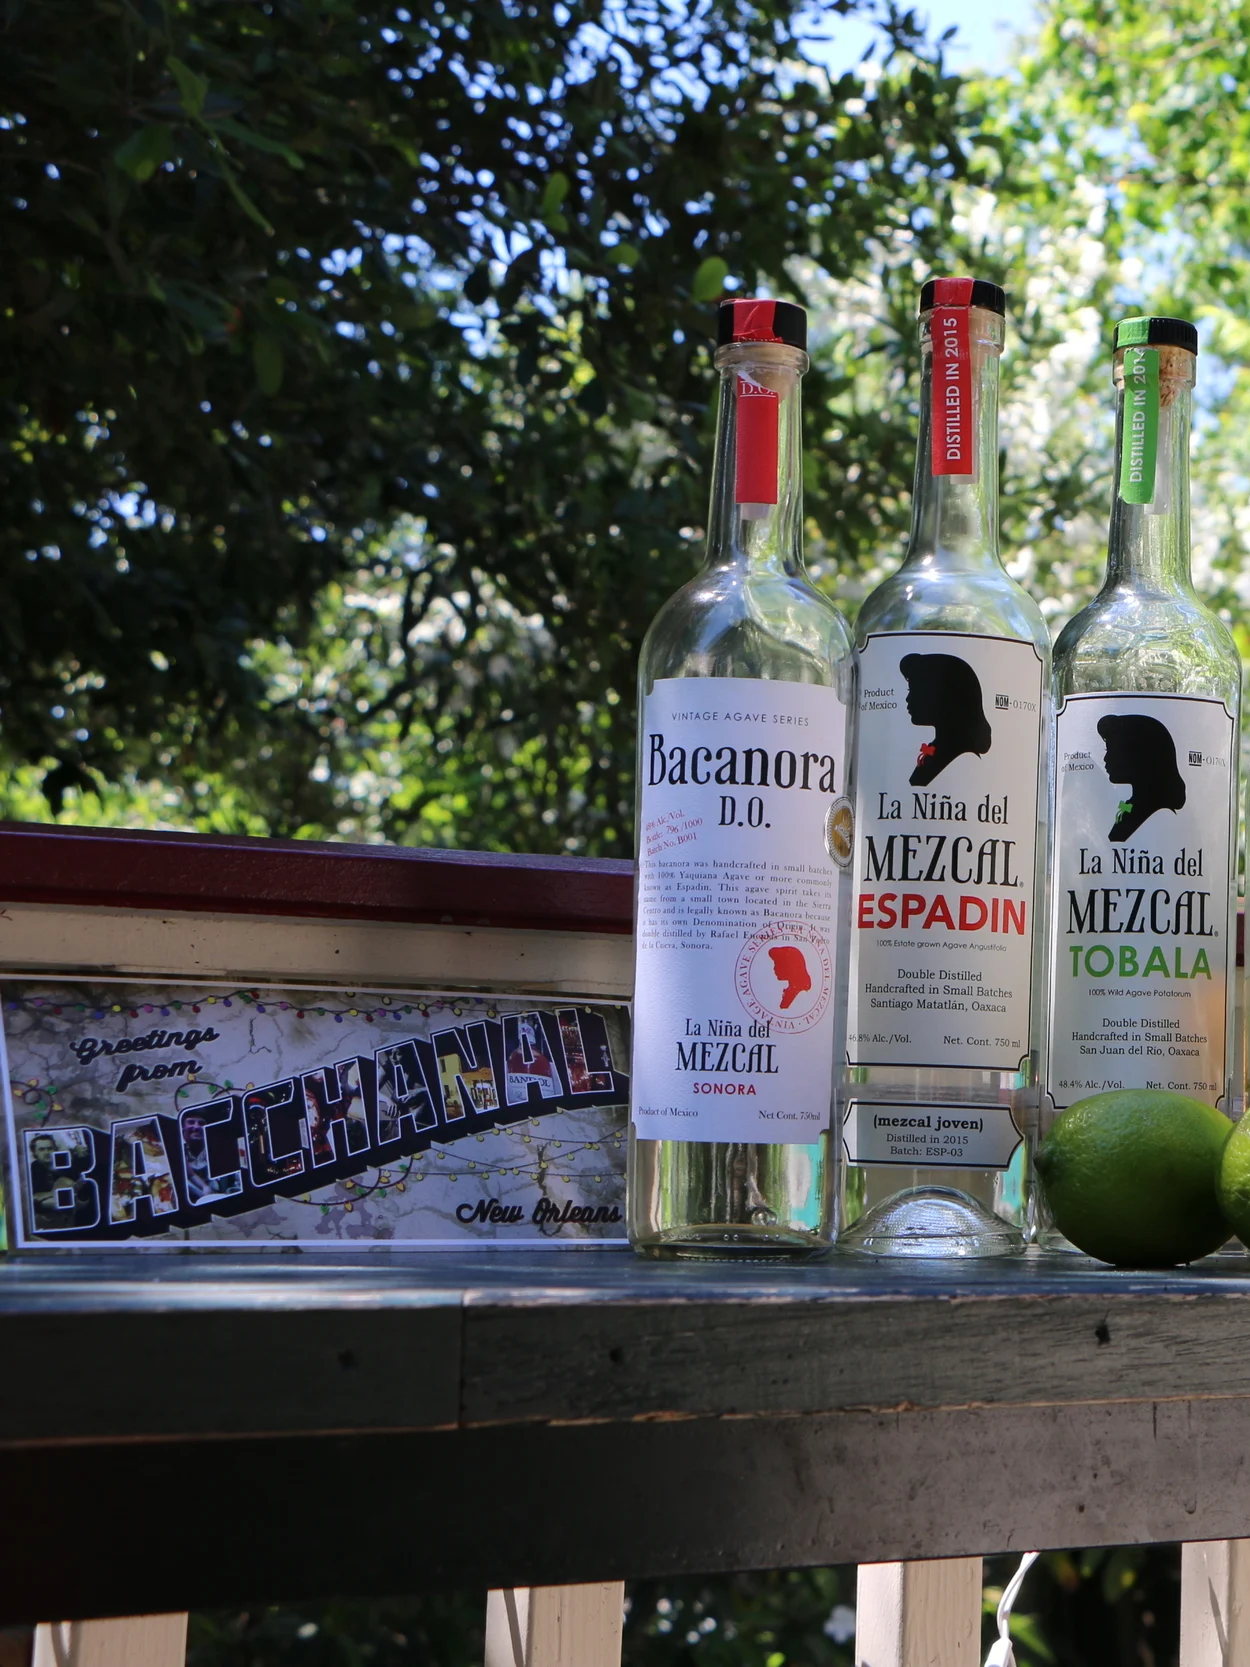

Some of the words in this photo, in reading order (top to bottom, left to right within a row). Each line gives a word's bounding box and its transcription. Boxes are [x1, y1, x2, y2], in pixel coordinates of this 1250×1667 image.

[944, 318, 958, 357] 2015
[945, 363, 959, 380] IN
[1133, 390, 1146, 405] IN
[946, 385, 961, 460] DISTILLED
[1130, 411, 1145, 482] DISTILLED
[864, 688, 894, 698] Product
[861, 703, 868, 711] of
[869, 702, 897, 710] Mexico
[672, 712, 718, 721] VINTAGE
[724, 713, 767, 723] AGAVE
[773, 715, 809, 726] SERIES
[648, 734, 836, 793] Bacanora
[719, 796, 771, 829] D.O.
[878, 792, 902, 819] La
[912, 793, 967, 821] Niña
[978, 794, 1008, 824] del
[864, 835, 1018, 887] MEZCAL
[1079, 848, 1102, 875] La
[1112, 848, 1164, 875] Niña
[1174, 848, 1203, 876] del
[858, 892, 1026, 935] ESPADIN
[1066, 888, 1213, 937] MEZCAL
[877, 940, 892, 948] 100%
[894, 940, 915, 948] Estate
[917, 941, 941, 949] grown
[942, 942, 967, 950] Agave
[969, 943, 1007, 952] Angustifolia
[1069, 945, 1212, 980] TOBALA
[898, 969, 935, 980] Double
[939, 970, 982, 981] Distilled
[865, 984, 925, 994] Handcrafted
[929, 984, 939, 994] in
[943, 985, 973, 996] Small
[977, 987, 1012, 998] Batches
[1109, 989, 1124, 997] Wild
[1126, 990, 1151, 998] Agave
[1154, 990, 1191, 998] Potatorum
[871, 999, 913, 1011] Santiago
[917, 999, 968, 1012] Matatlán,
[972, 1002, 1006, 1013] Oaxaca
[685, 1018, 701, 1036] La
[708, 1019, 742, 1038] Niña
[749, 1019, 771, 1038] del
[1103, 1018, 1137, 1028] Double
[1141, 1019, 1180, 1029] Distilled
[70, 1027, 220, 1065] Greetings
[872, 1034, 912, 1044] Alc./Vol.
[944, 1036, 963, 1045] Net.
[967, 1037, 991, 1046] Cont.
[995, 1038, 1009, 1047] 750
[1012, 1040, 1020, 1048] ml
[1072, 1032, 1128, 1042] Handcrafted
[1132, 1033, 1141, 1042] in
[1145, 1033, 1172, 1042] Small
[1175, 1034, 1207, 1044] Batches
[675, 1042, 779, 1073] MEZCAL
[1080, 1046, 1097, 1055] San
[1100, 1046, 1125, 1055] Juan
[1128, 1046, 1143, 1055] del
[1168, 1047, 1200, 1057] Oaxaca
[116, 1060, 203, 1092] from
[693, 1082, 756, 1096] SONORA
[1059, 1080, 1082, 1089] 48.4%
[1085, 1080, 1125, 1090] Alc./Vol.
[22, 1007, 616, 1234] BACCHANAL
[874, 1114, 931, 1129] (mezcal
[935, 1116, 983, 1132] joven)
[887, 1134, 926, 1143] Distilled
[930, 1135, 939, 1143] in
[944, 1136, 969, 1144] 2015
[890, 1146, 921, 1155] Batch:
[926, 1148, 963, 1157] ESP-03
[456, 1198, 524, 1223] New
[532, 1197, 622, 1224] Orleans
